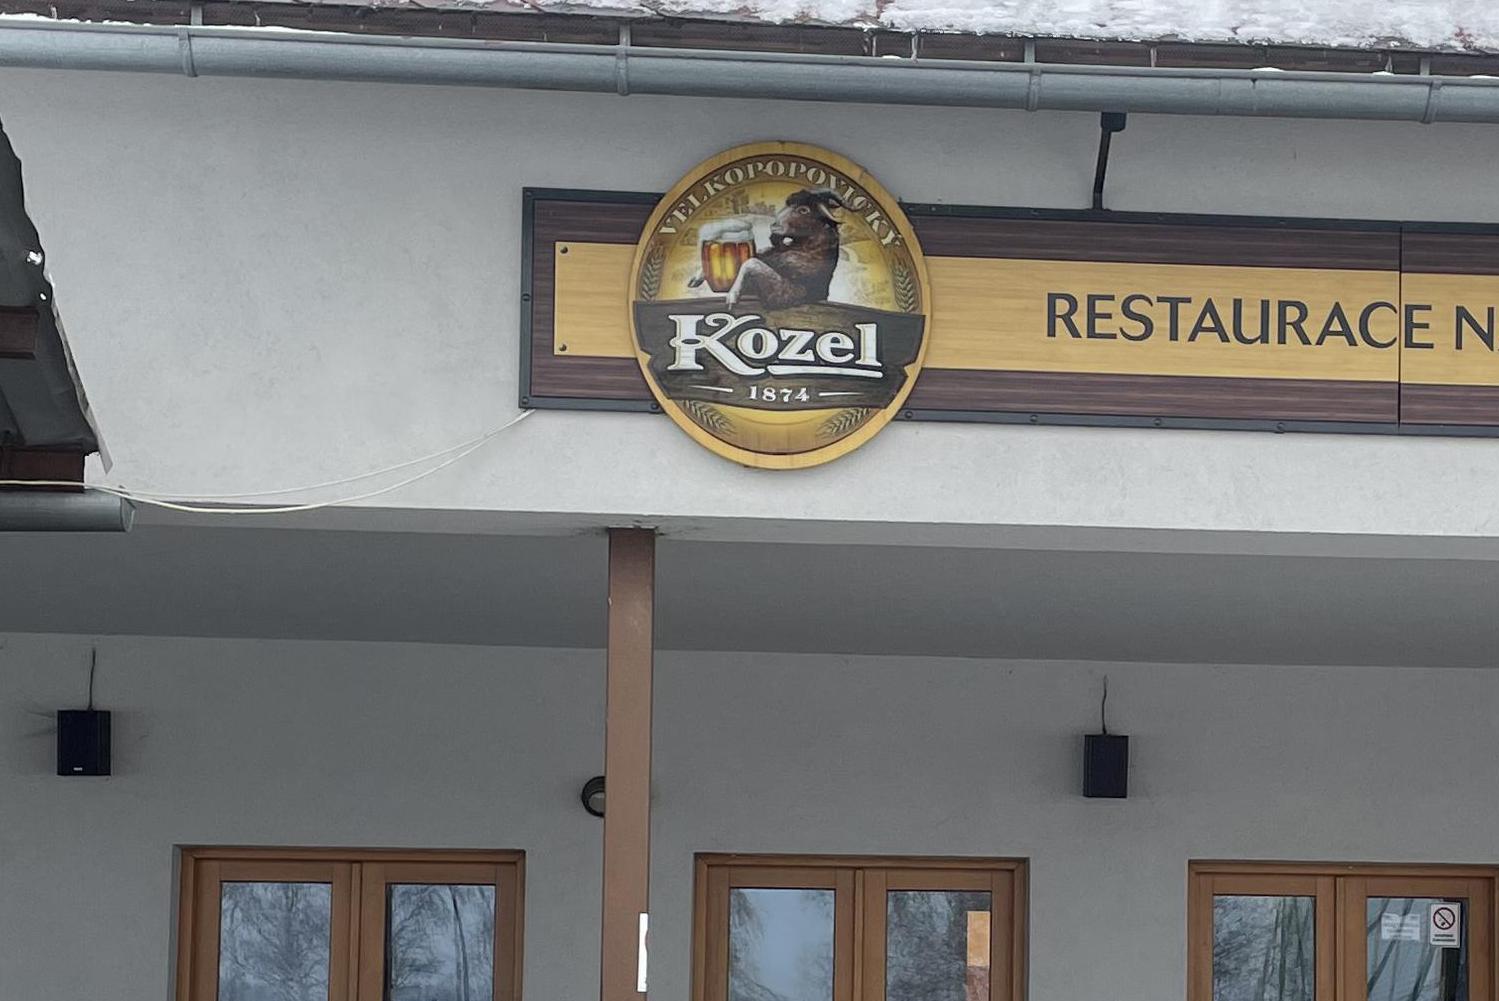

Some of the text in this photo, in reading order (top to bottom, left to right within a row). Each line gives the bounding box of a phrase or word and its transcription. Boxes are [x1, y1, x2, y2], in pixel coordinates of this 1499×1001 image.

[667, 312, 884, 379] Kozel
[1046, 292, 1435, 350] RESTAURACE
[749, 386, 811, 402] 1874
